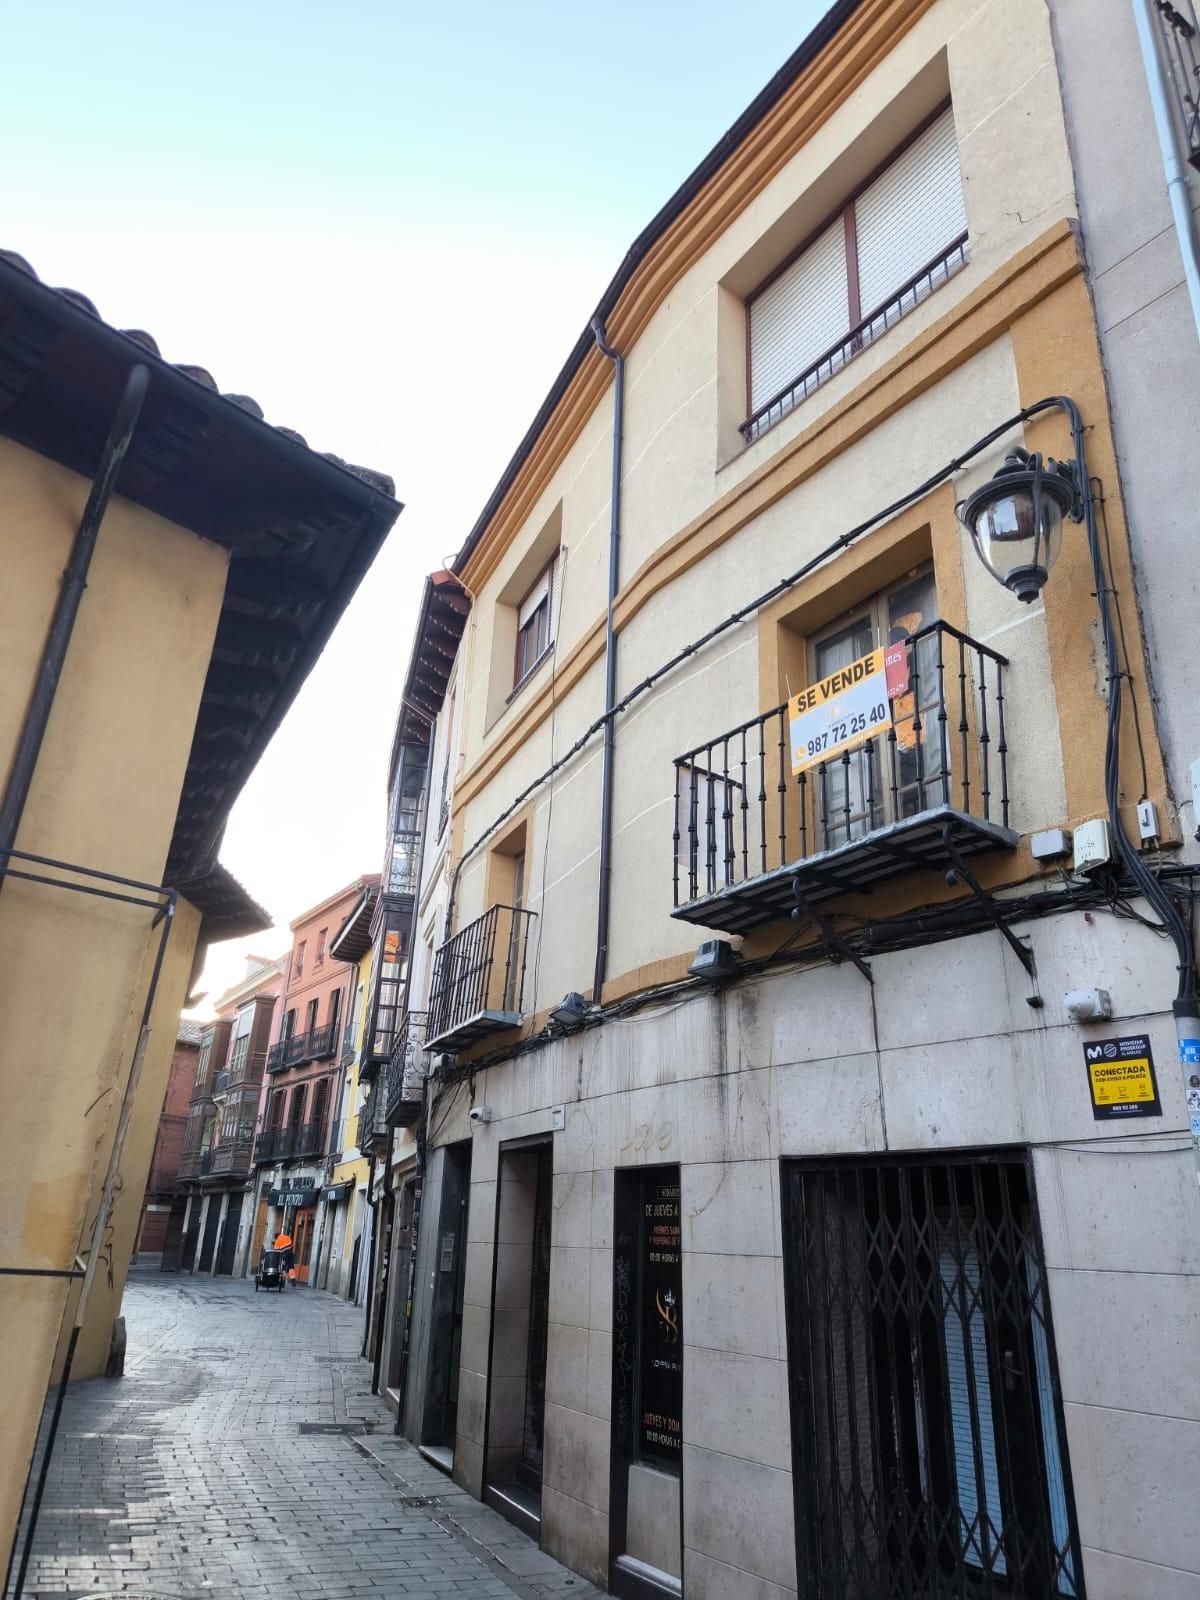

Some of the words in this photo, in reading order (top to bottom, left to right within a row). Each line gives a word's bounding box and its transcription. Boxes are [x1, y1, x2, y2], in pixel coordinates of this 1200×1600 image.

[797, 689, 817, 713] SE
[820, 655, 875, 699] VENDE
[807, 732, 828, 756] 987
[832, 723, 848, 743] 72
[850, 713, 866, 734] 25
[870, 703, 885, 723] 40
[1094, 1065, 1146, 1077] CONECTADA
[645, 1205, 652, 1216] DE
[654, 1205, 673, 1216] JUEVES
[644, 1412, 662, 1427] JUEVES
